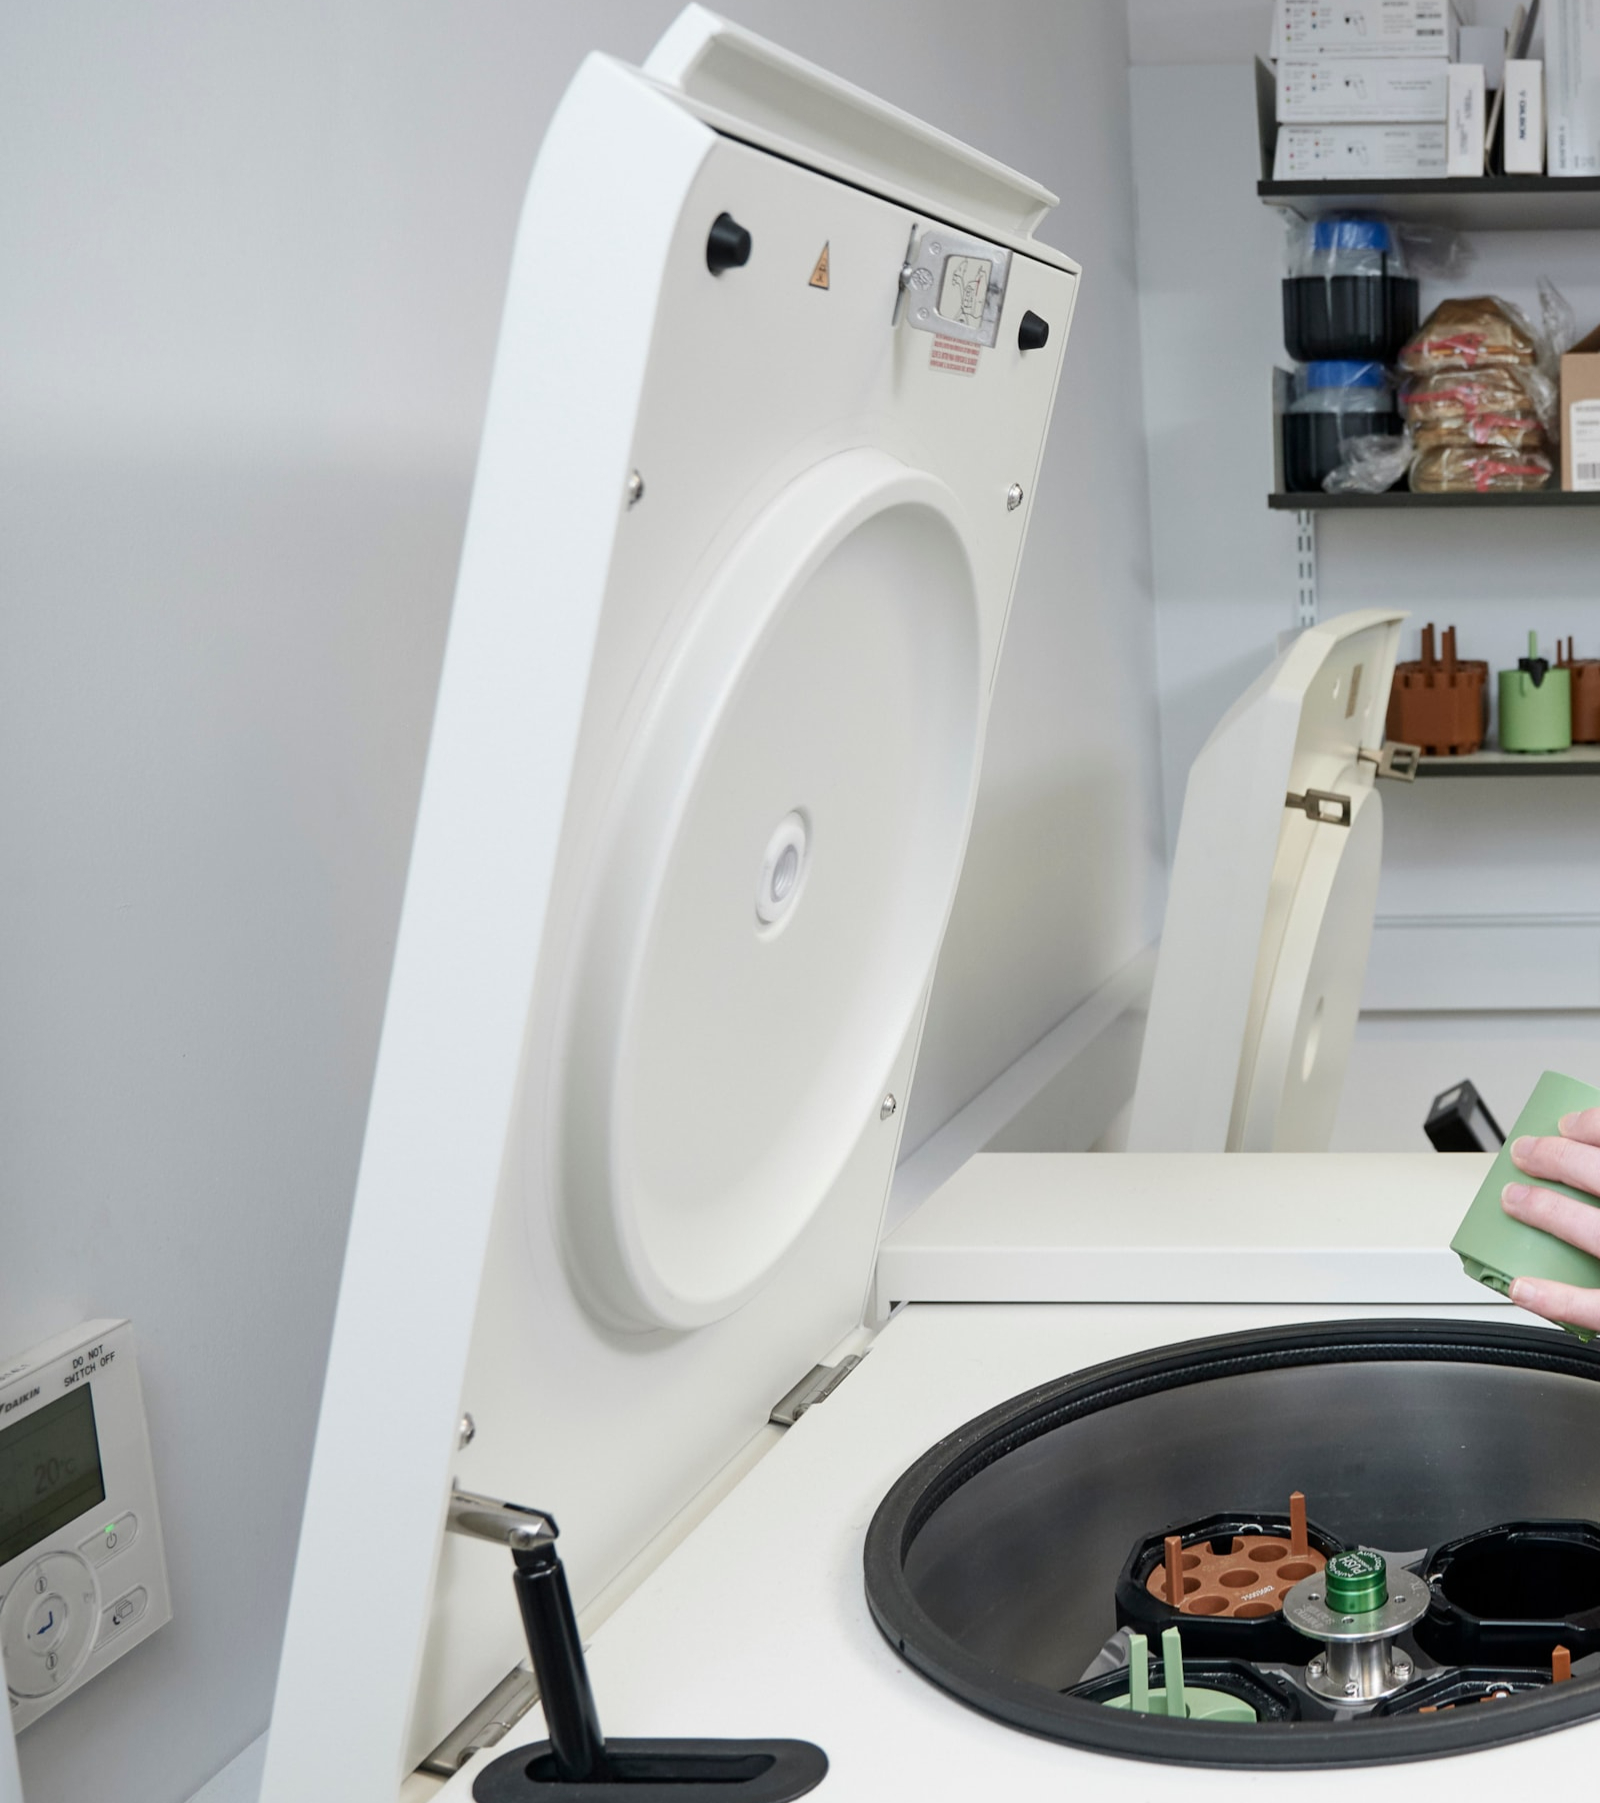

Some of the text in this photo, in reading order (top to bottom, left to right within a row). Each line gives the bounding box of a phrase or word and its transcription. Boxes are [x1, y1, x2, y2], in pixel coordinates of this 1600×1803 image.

[64, 1351, 116, 1387] SWITCH OFF
[72, 1344, 104, 1369] DO NOT
[4, 1386, 41, 1413] DAIKIN
[1338, 1555, 1368, 1575] PUSH
